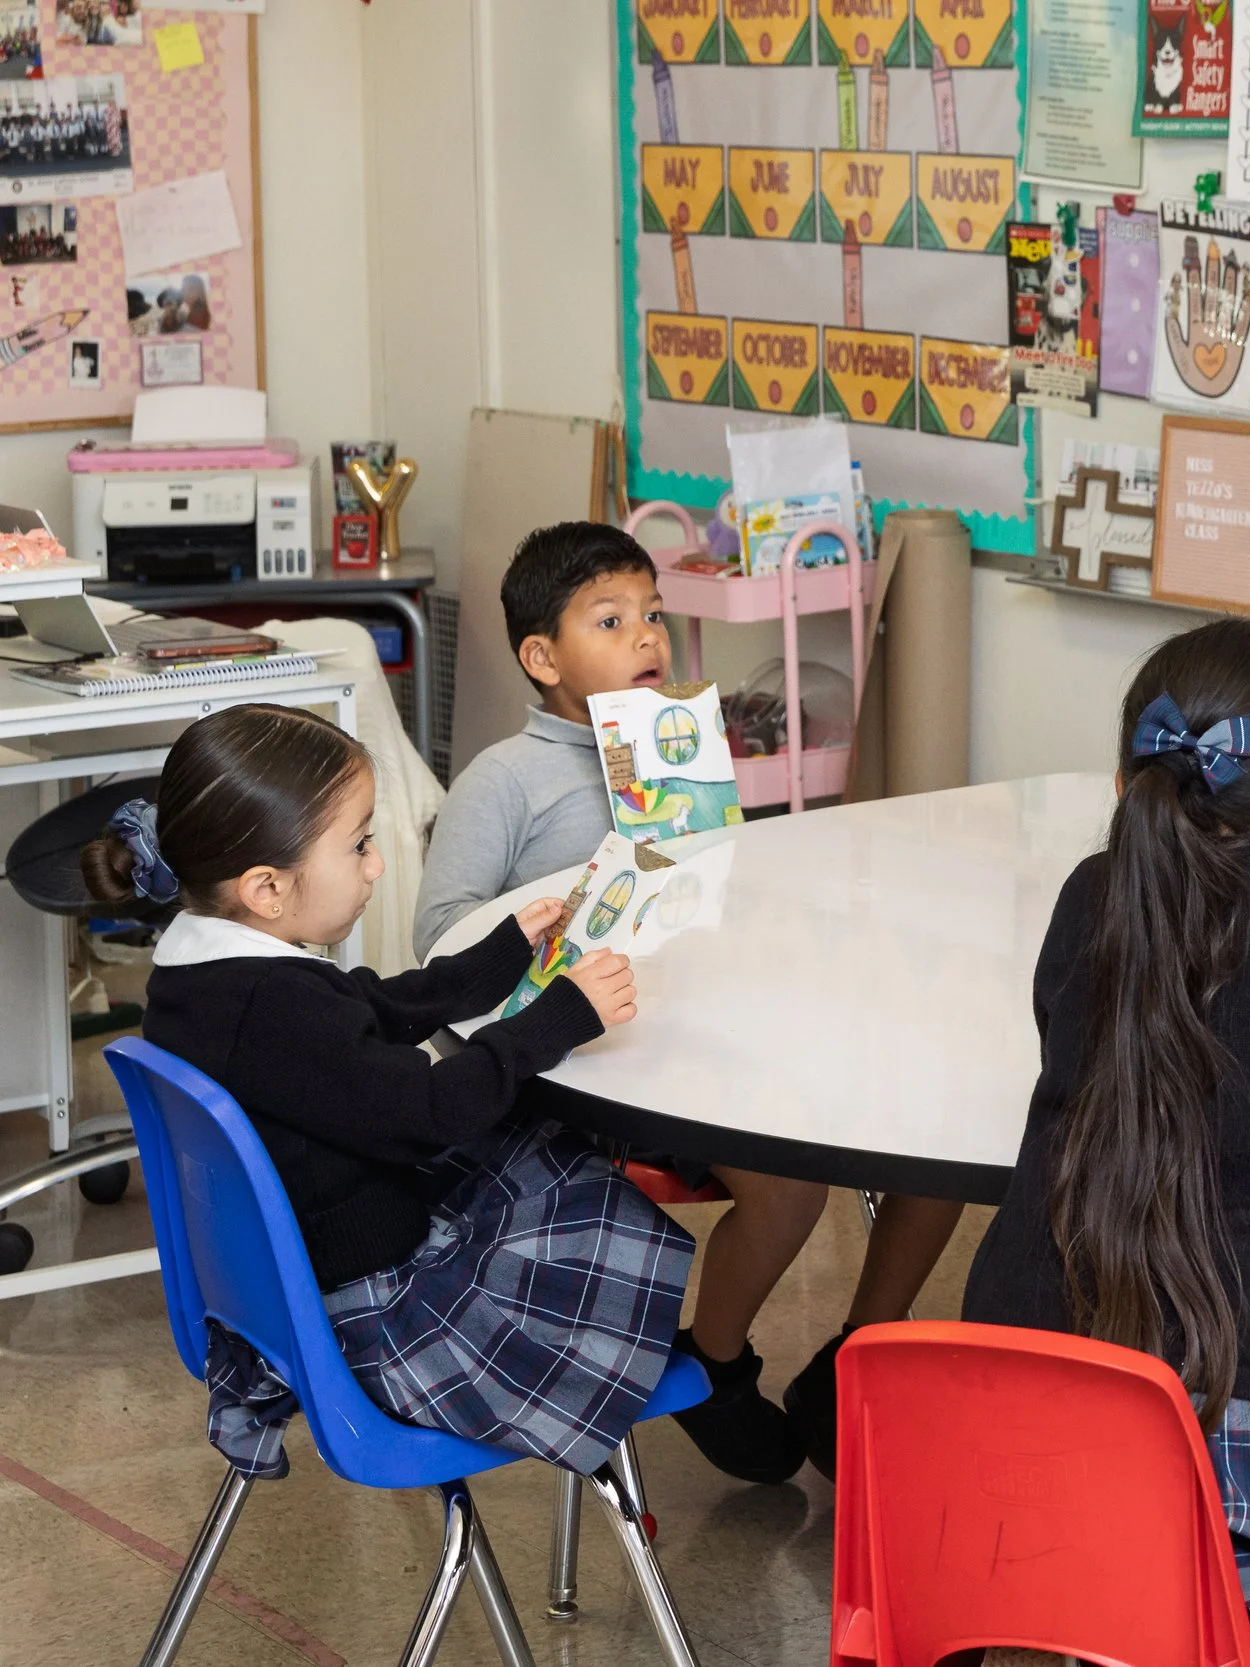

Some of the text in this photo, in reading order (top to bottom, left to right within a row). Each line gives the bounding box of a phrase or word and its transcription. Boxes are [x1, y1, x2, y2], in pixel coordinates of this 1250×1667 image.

[1193, 34, 1224, 59] Smart
[1192, 61, 1224, 91] Safety
[664, 156, 700, 190] MAY
[751, 159, 789, 194] JUNE
[845, 162, 884, 198] JULY
[931, 166, 999, 204] AUGUST
[1163, 201, 1250, 235] RETELLING
[651, 323, 723, 360] SEPTEMBER
[742, 332, 807, 368] OCTOBER
[826, 340, 910, 380] NOVEMBER
